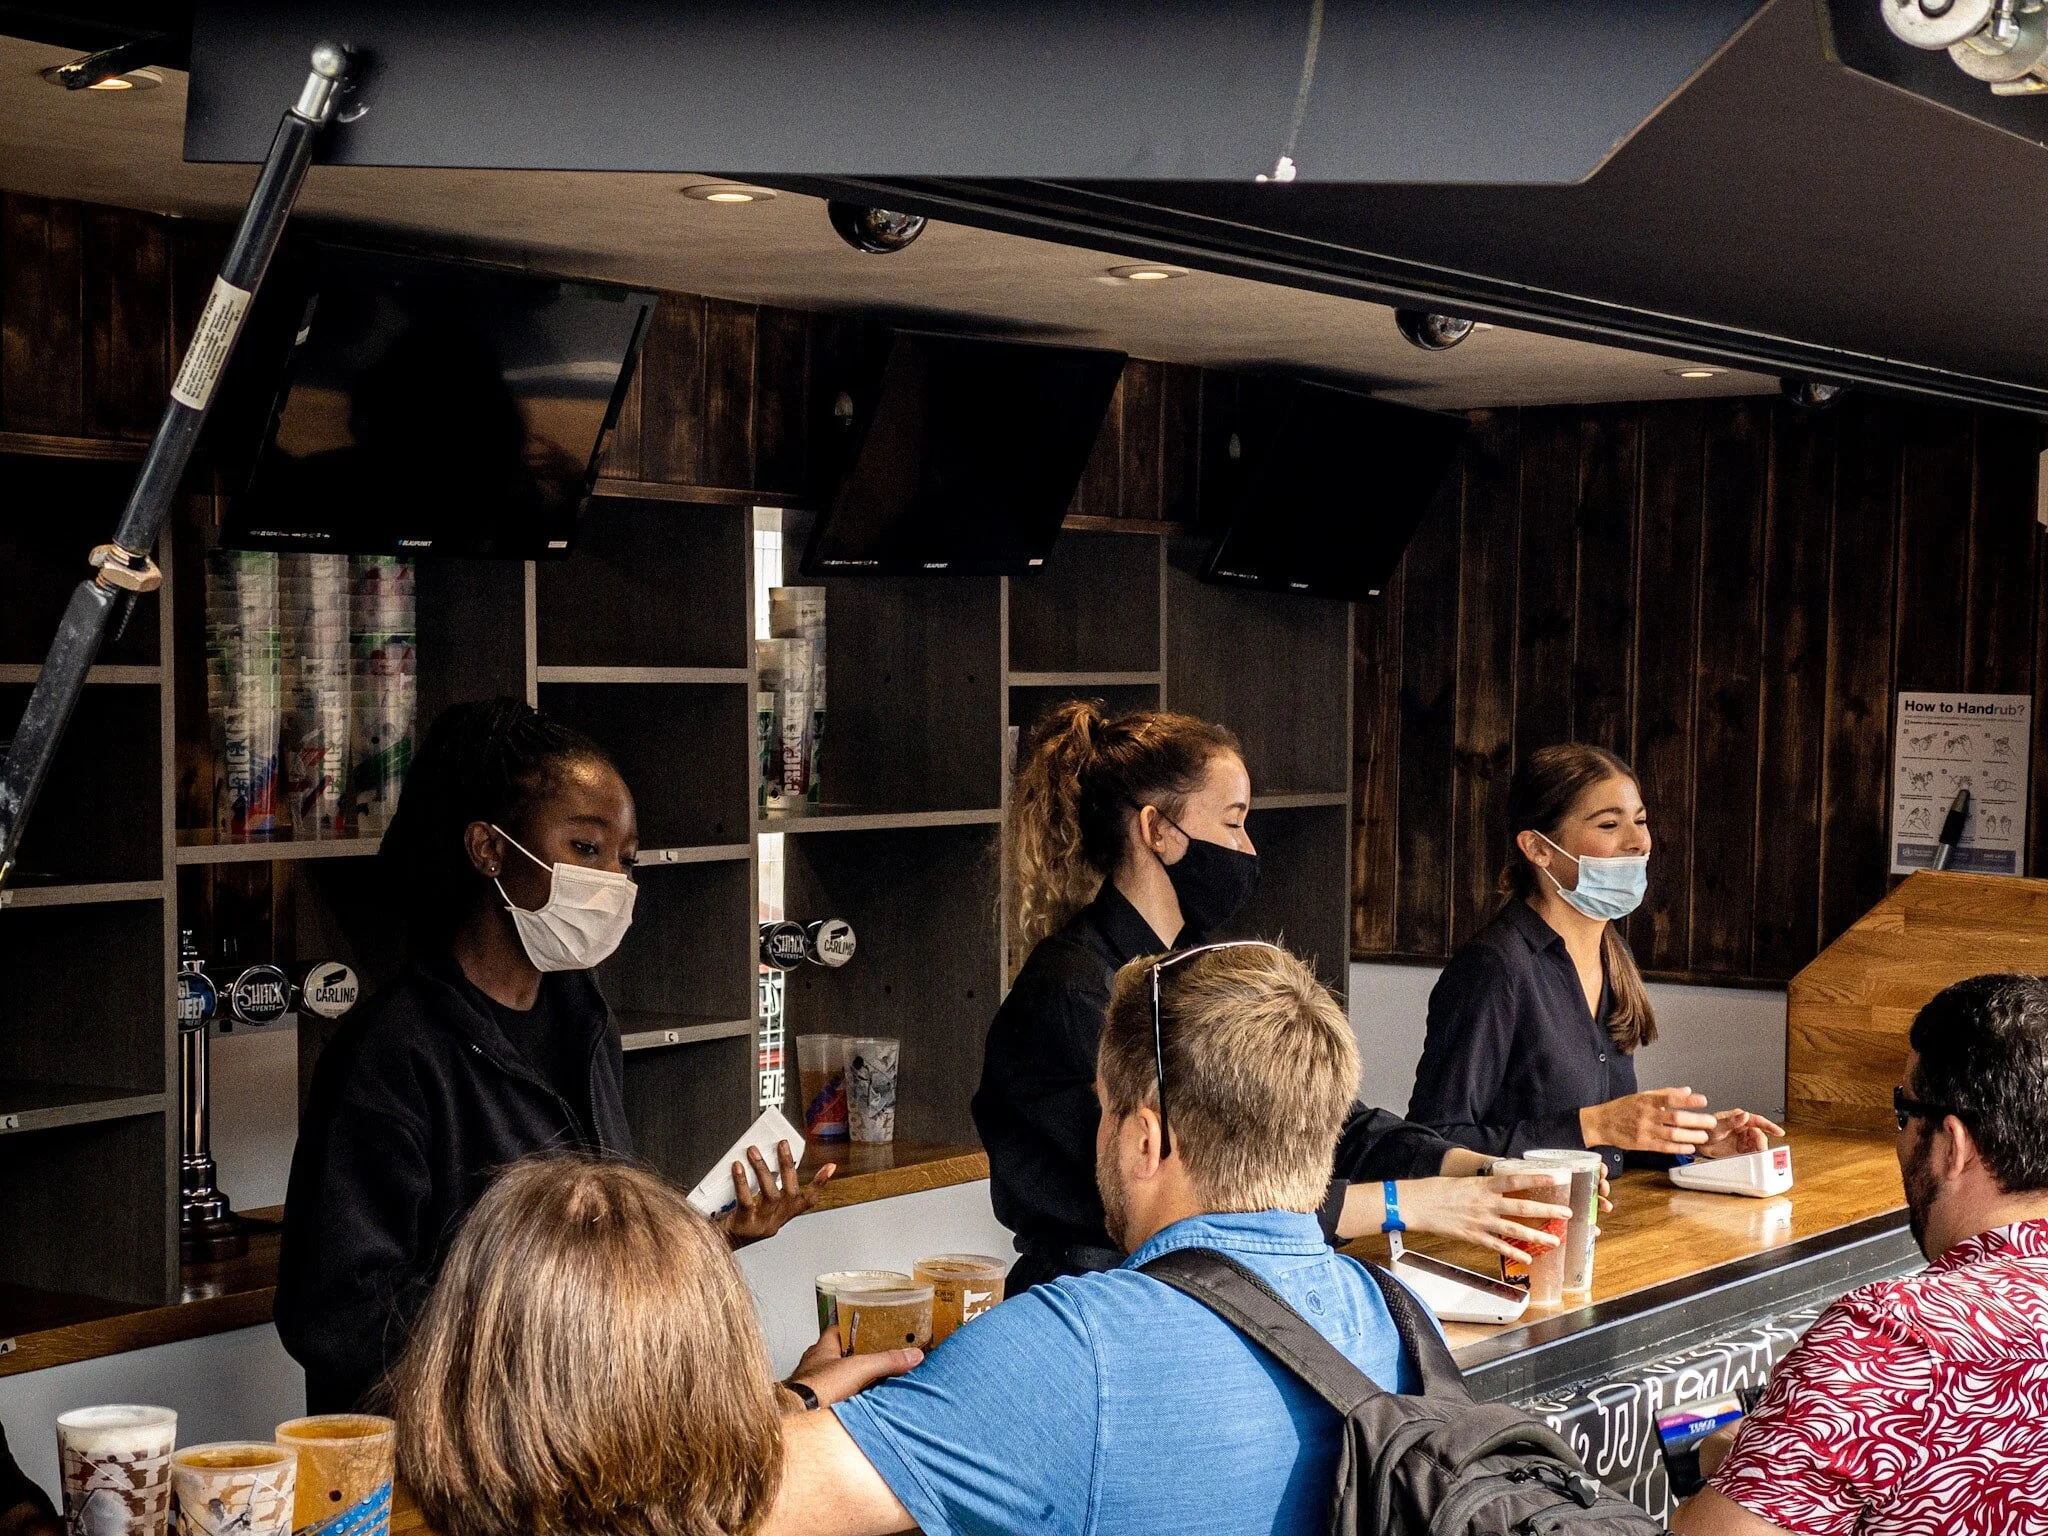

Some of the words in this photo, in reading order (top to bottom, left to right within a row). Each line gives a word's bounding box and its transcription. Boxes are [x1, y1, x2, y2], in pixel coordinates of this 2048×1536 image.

[1904, 700, 1936, 713] How
[1940, 702, 1953, 713] to
[1957, 702, 2025, 716] Handrub?
[773, 934, 806, 957] SHACK
[824, 939, 855, 956] CARLING
[237, 981, 286, 1007] SHACK
[315, 987, 356, 1003] CARLING
